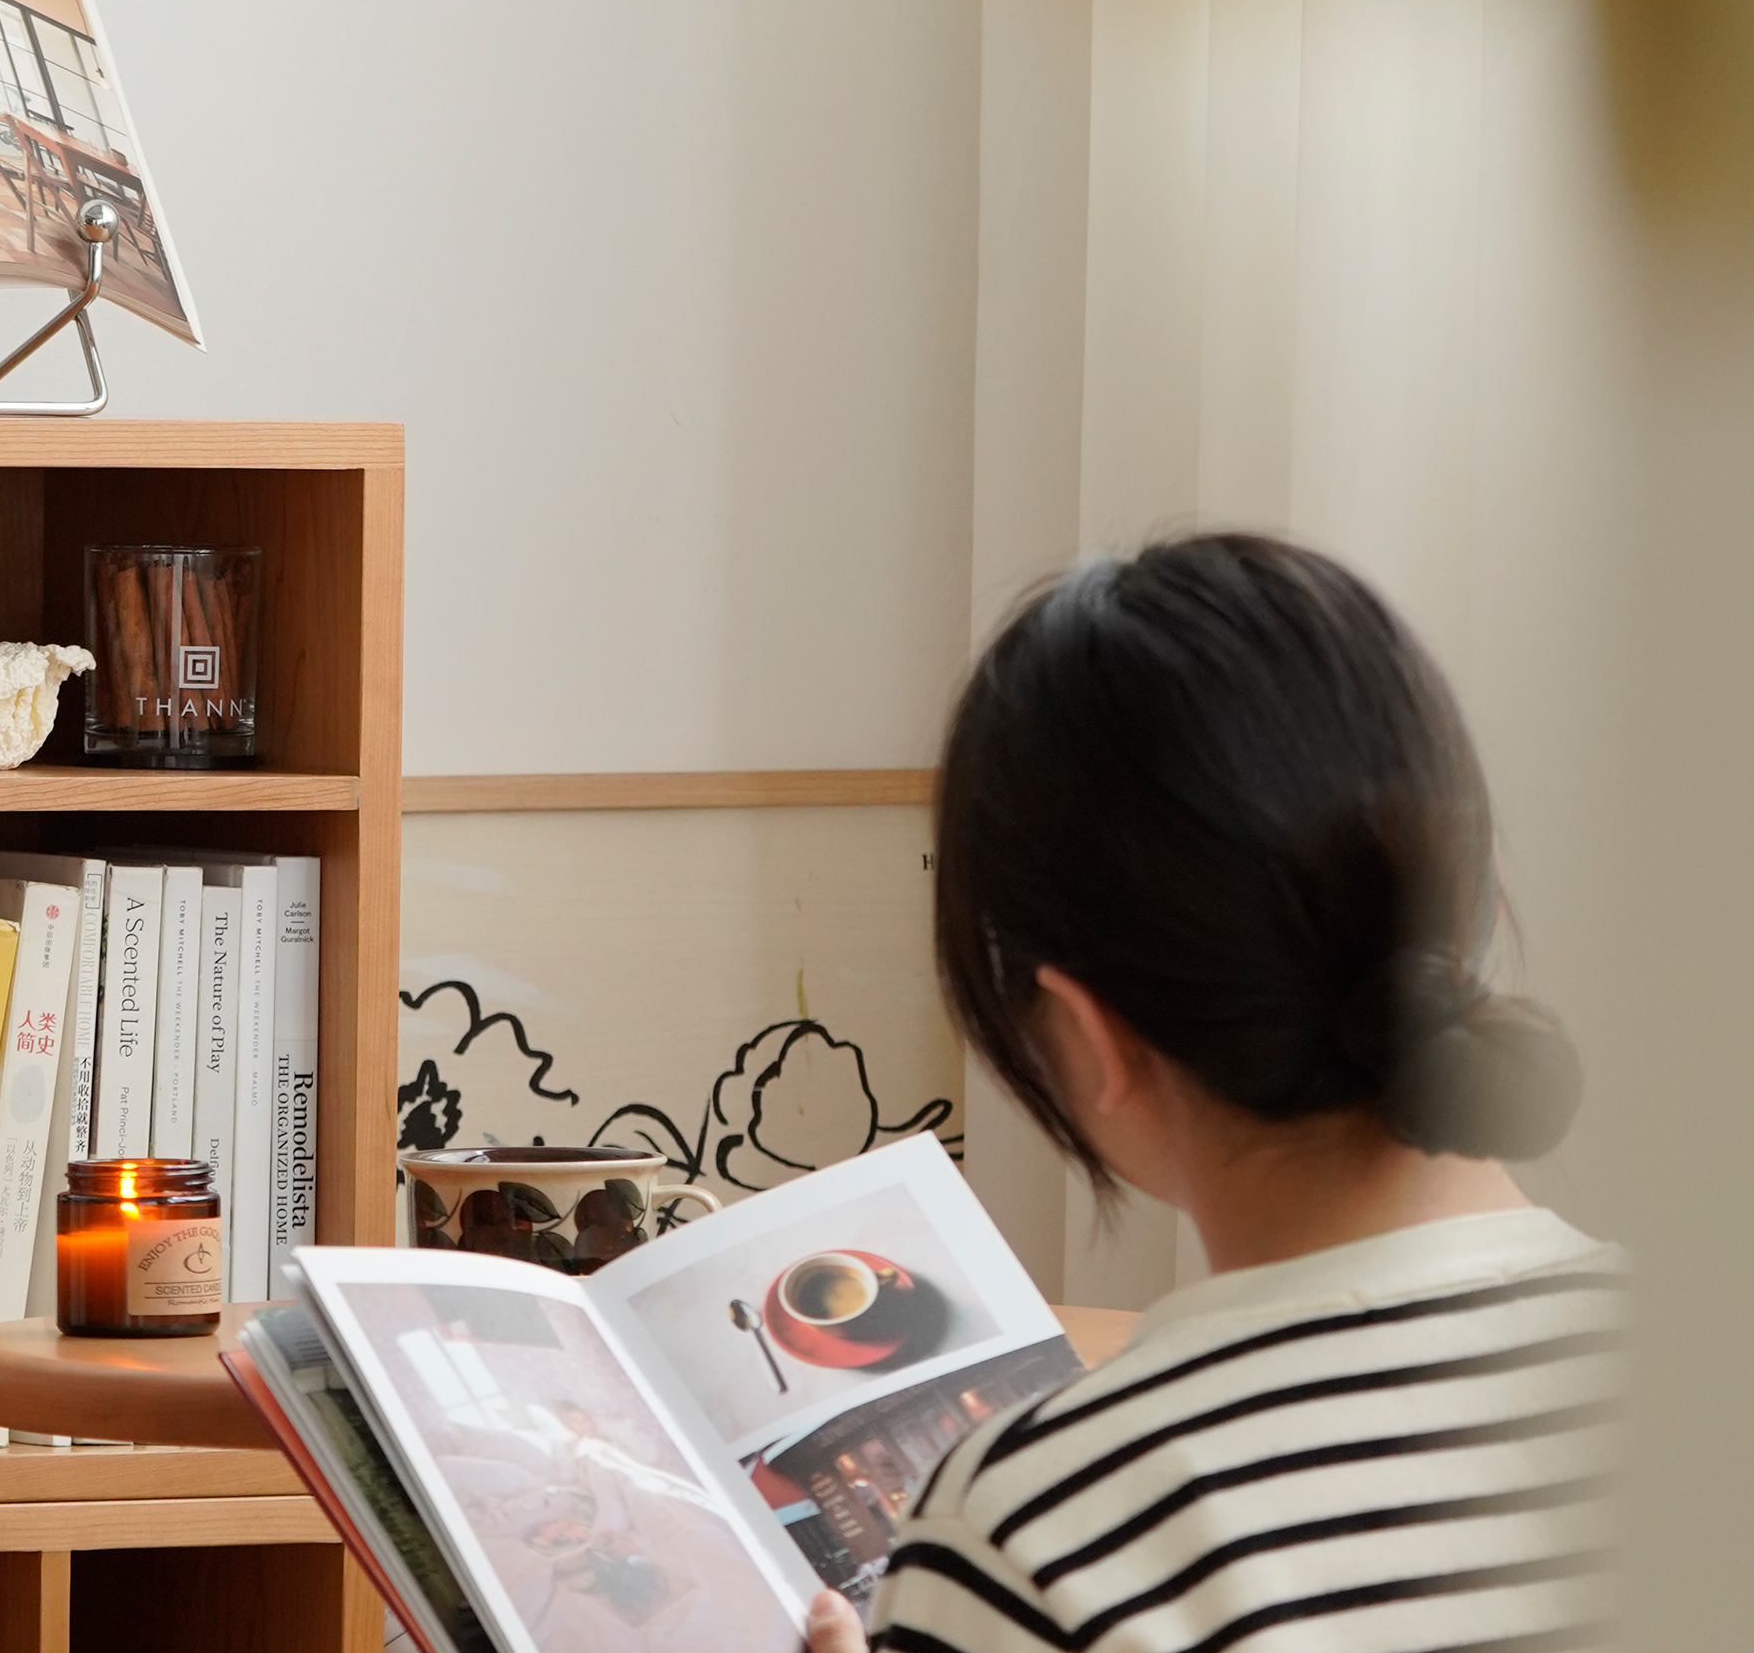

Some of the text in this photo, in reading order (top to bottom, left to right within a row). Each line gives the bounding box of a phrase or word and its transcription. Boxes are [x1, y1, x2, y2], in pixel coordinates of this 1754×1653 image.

[136, 697, 243, 718] THANN
[178, 899, 186, 924] TOBY
[256, 898, 264, 924] TOBY
[284, 909, 312, 918] Carlson
[289, 901, 307, 909] Julie
[176, 929, 185, 976] MITCHELL
[254, 929, 263, 976] MITCHELL
[281, 935, 315, 944] Guralnick
[285, 927, 311, 936] Margot
[78, 912, 97, 1008] COMFORTABLE
[118, 897, 145, 1058] A Scented Life
[206, 912, 229, 1074] The Nature of Play
[16, 1031, 56, 1057] 简史
[17, 1009, 58, 1034] 人类
[74, 1010, 92, 1050] HOME
[173, 1000, 183, 1061] WEEKENDER
[252, 1000, 261, 1060] WEEKENDER
[74, 1056, 92, 1153] 不用收拾就整齐
[121, 1086, 130, 1104] Pat
[170, 1072, 180, 1124] PORTLAND
[275, 1054, 291, 1246] THE ORGANIZED HOME
[291, 1071, 315, 1229] Remodelista
[13, 1139, 37, 1233] 从动物到上帝
[137, 1227, 199, 1272] ENJOY THE
[155, 1284, 203, 1295] SCENTED
